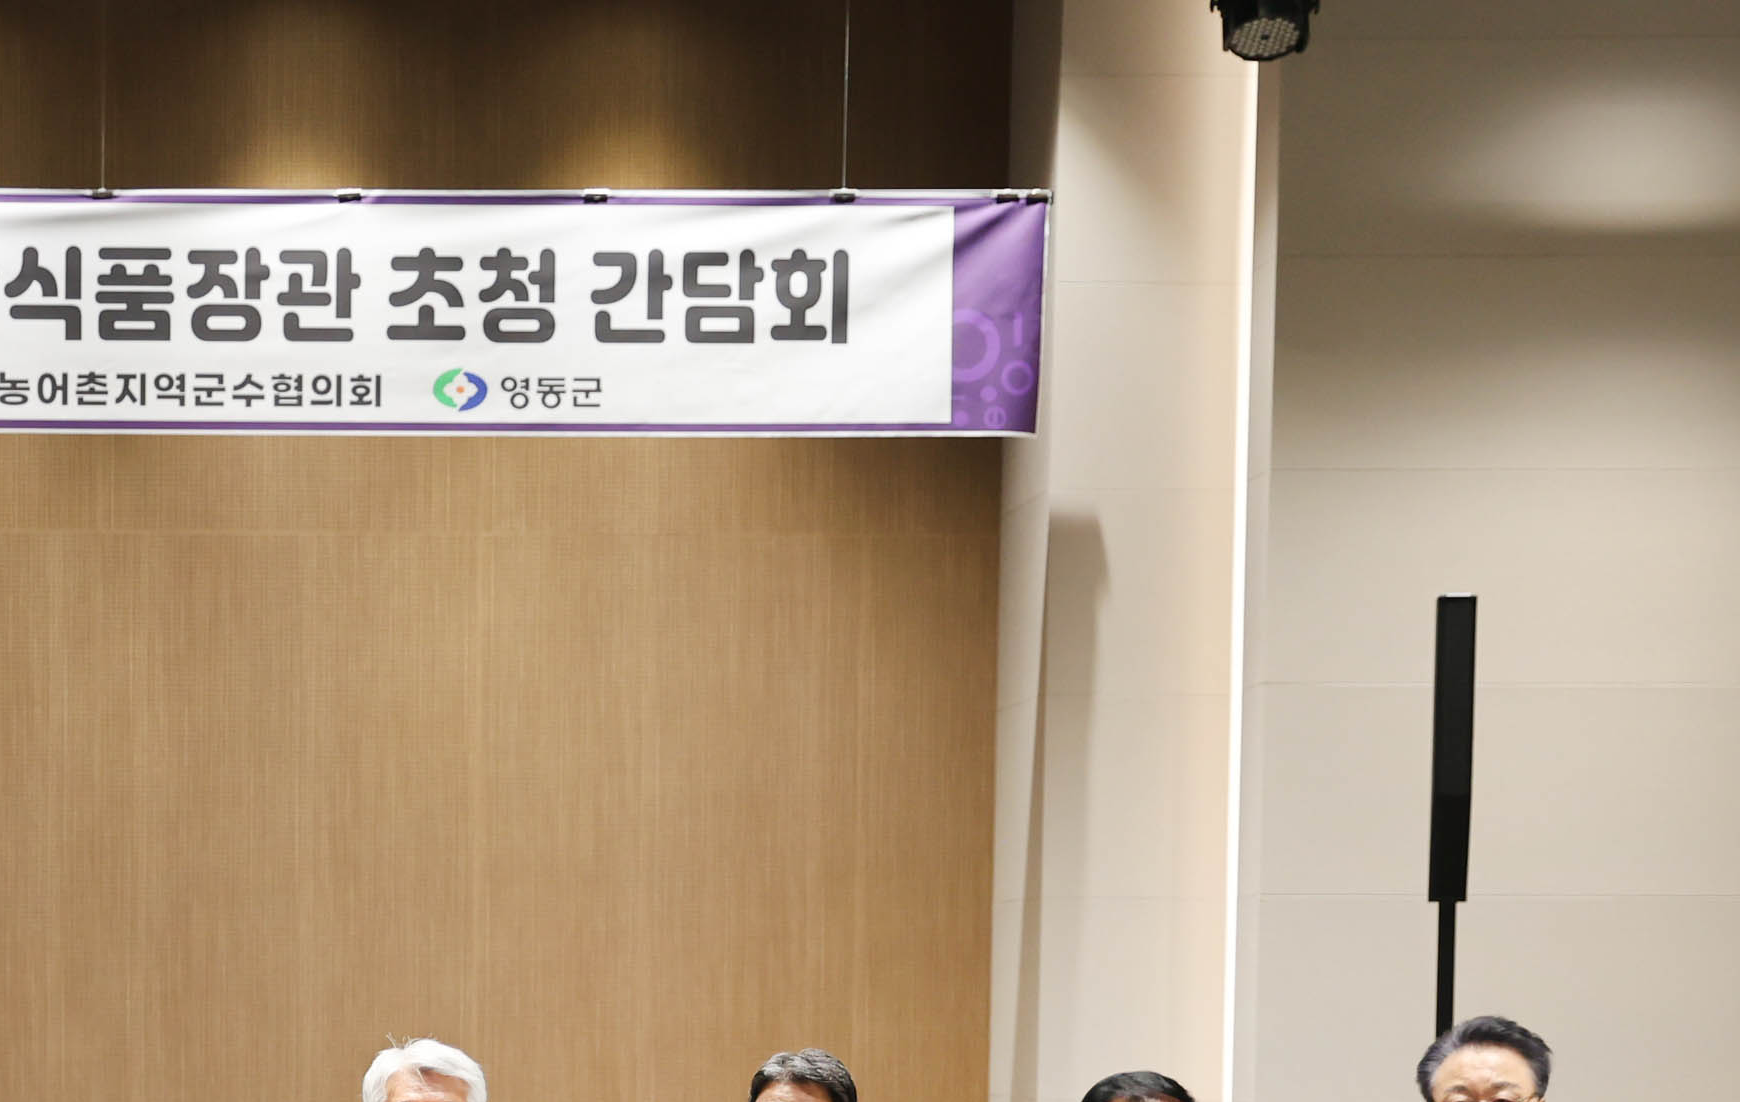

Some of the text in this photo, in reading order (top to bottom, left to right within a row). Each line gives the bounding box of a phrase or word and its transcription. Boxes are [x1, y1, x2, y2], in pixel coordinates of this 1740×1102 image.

[387, 248, 555, 342] 초청
[591, 249, 848, 343] 간담회
[501, 377, 601, 409] 영동군
